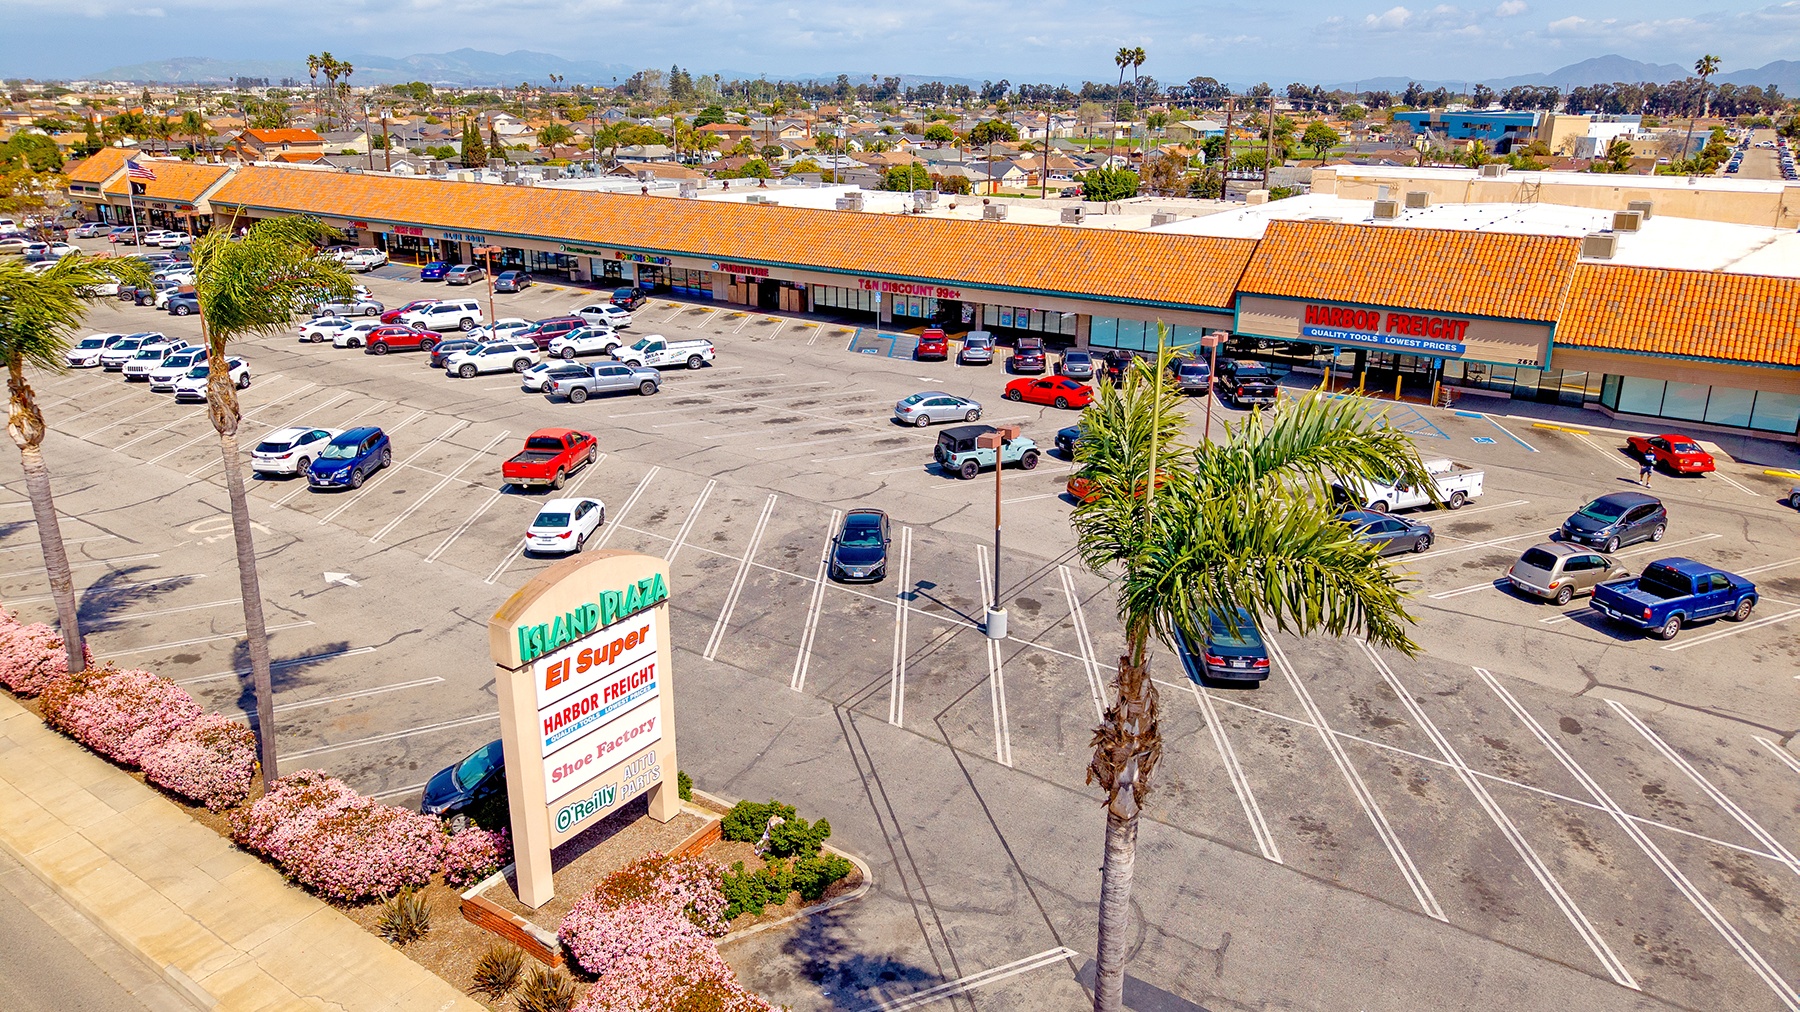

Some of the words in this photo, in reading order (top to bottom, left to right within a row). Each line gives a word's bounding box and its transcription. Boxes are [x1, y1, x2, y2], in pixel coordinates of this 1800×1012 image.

[720, 263, 769, 277] FURNITURE
[858, 279, 879, 290] T&N
[882, 282, 934, 296] DISCOUNT
[1305, 305, 1380, 331] HARBOR
[1386, 313, 1469, 341] FREIGHT
[1311, 329, 1348, 339] QUALITY
[1350, 333, 1378, 342] TOOLS
[1385, 337, 1420, 347] LOWEST
[1423, 342, 1457, 351] PRICES
[518, 602, 599, 662] ISLAND
[599, 573, 668, 625] PLAZA
[545, 657, 571, 690] El
[576, 624, 650, 674] Super
[543, 693, 599, 736] HARBOR
[603, 663, 656, 704] FREIGHT
[550, 722, 579, 743] QUALITY
[580, 711, 601, 727] TOOLS
[604, 696, 629, 714] LOWEST
[630, 685, 651, 701] PRICES
[552, 753, 593, 784] Shoe
[596, 716, 656, 759] Factory
[623, 750, 656, 782] AUTO
[620, 766, 661, 801] PARTS
[556, 784, 616, 831] O'Reilly
